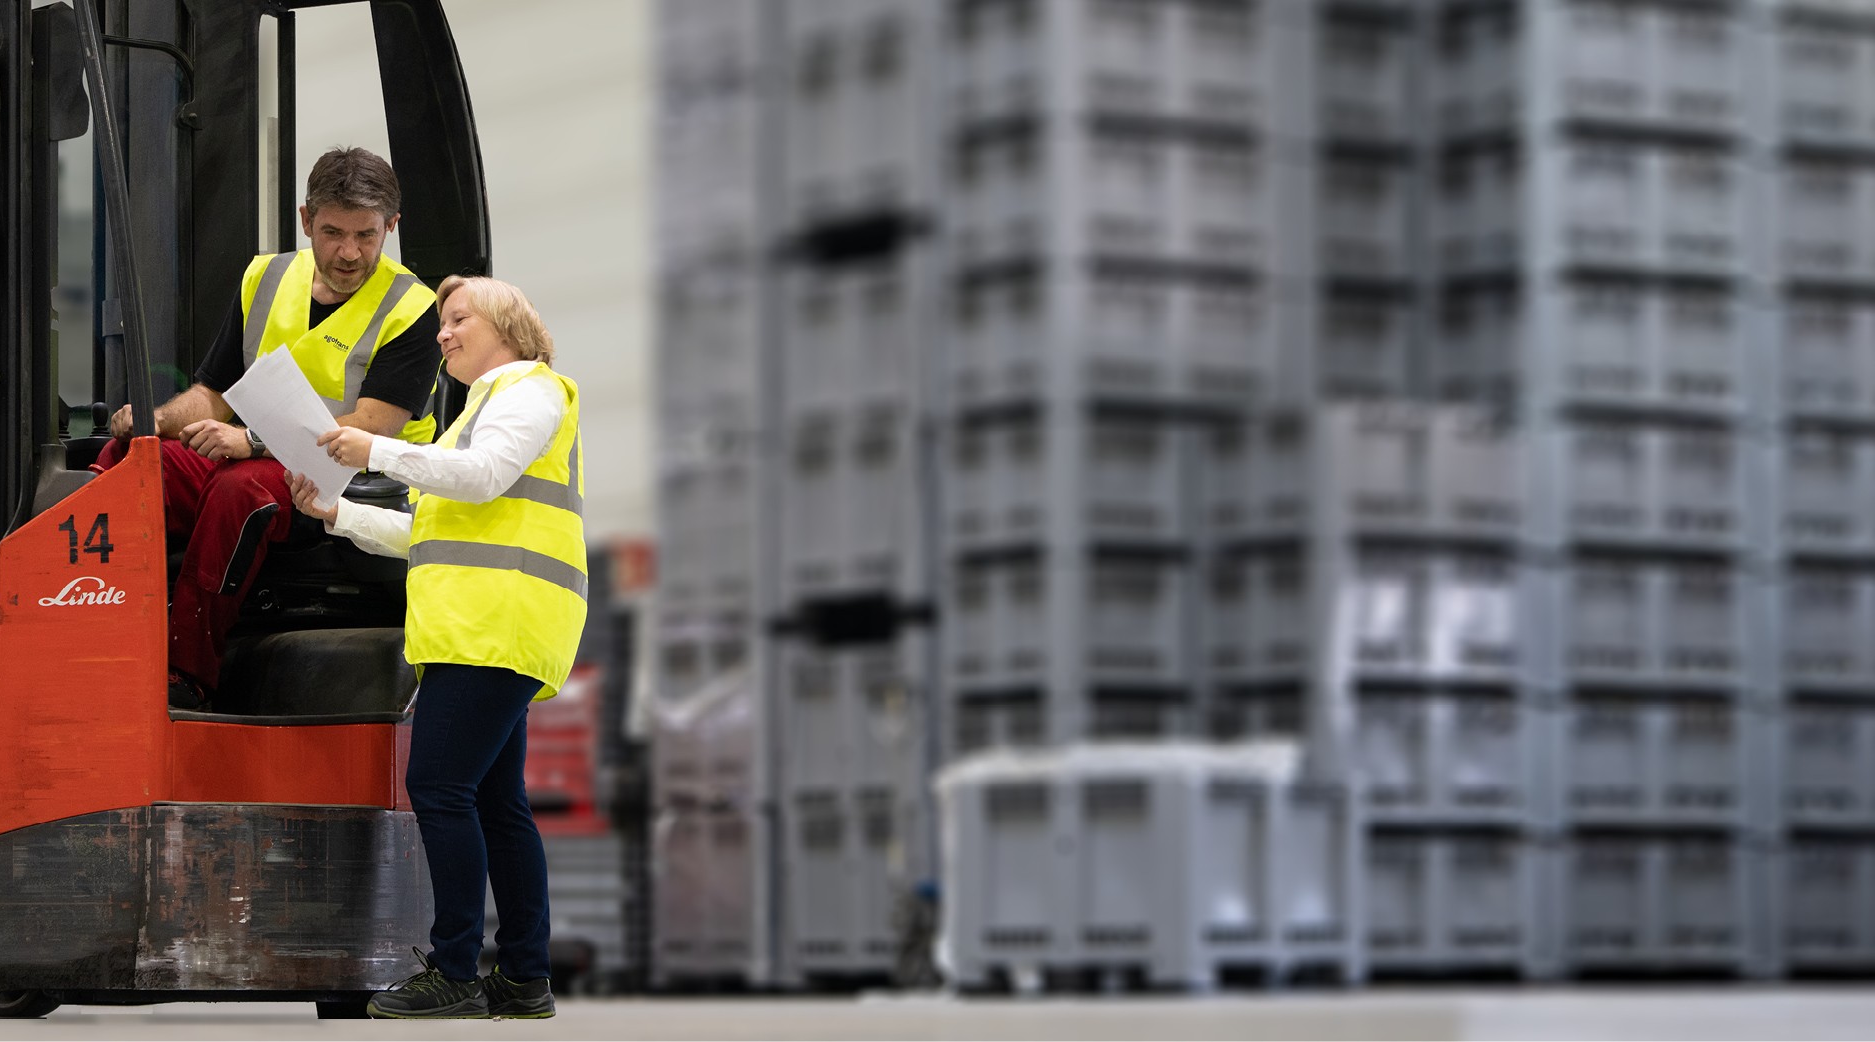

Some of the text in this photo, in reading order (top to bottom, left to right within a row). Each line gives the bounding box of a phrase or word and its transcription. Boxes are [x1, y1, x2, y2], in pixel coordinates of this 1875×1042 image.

[324, 334, 350, 350] agotrans
[58, 513, 114, 565] 14
[38, 576, 126, 607] Linde
